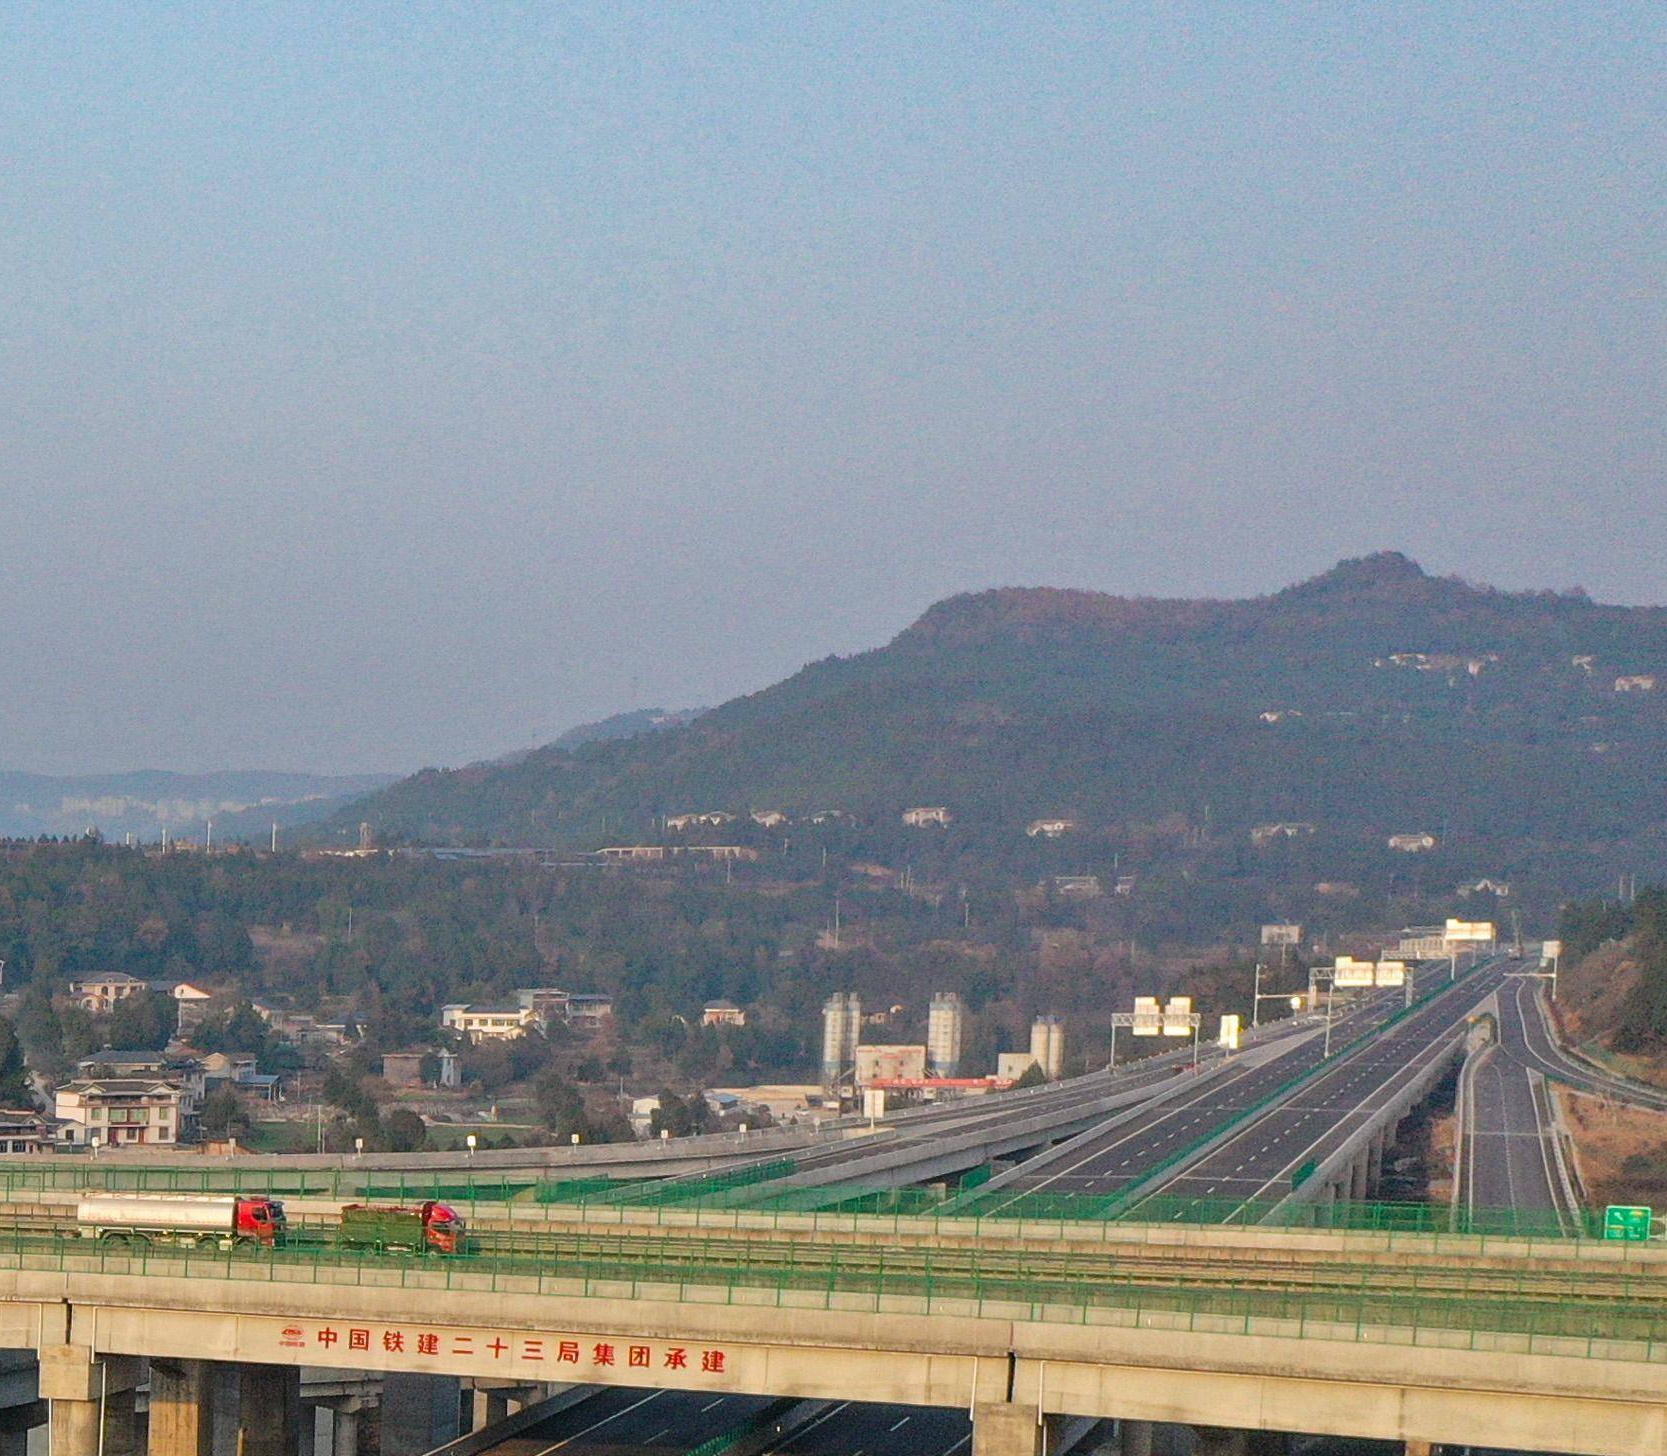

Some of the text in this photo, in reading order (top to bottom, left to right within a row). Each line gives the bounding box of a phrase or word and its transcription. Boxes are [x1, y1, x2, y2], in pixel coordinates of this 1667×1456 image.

[318, 1327, 725, 1373] 中国铁建二十三局集团承建
